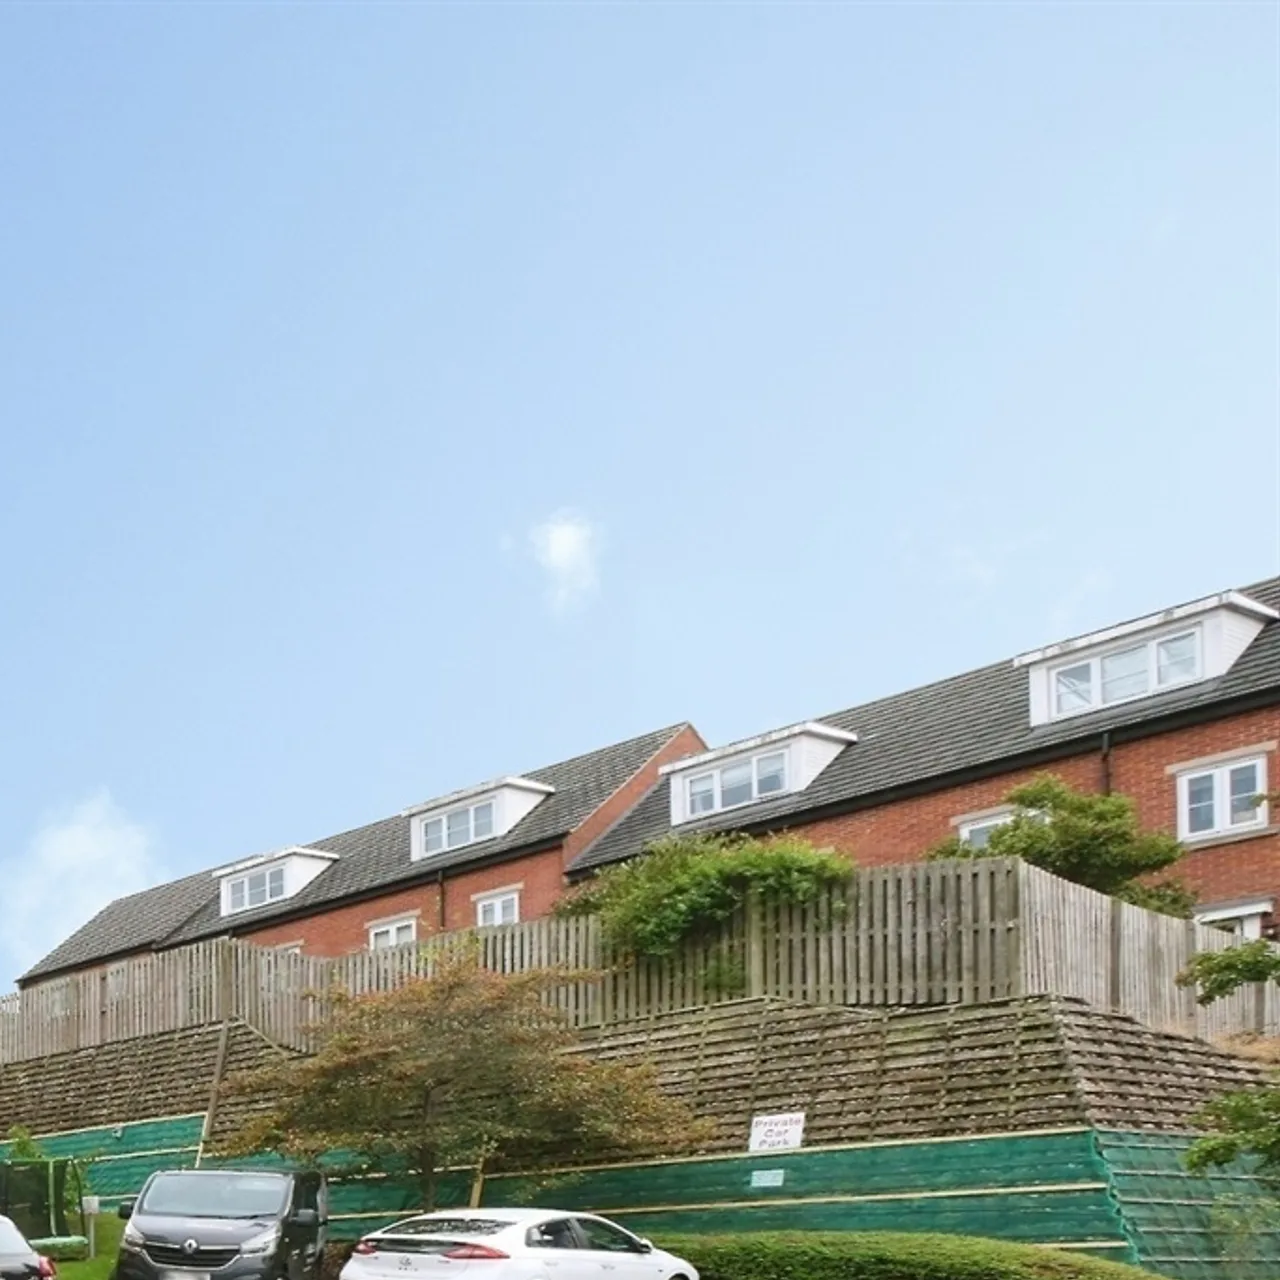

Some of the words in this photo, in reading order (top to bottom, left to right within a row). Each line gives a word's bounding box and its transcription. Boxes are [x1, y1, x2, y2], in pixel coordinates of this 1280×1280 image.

[754, 1118, 801, 1128] Private
[763, 1128, 789, 1138] Car
[758, 1138, 789, 1148] Park
